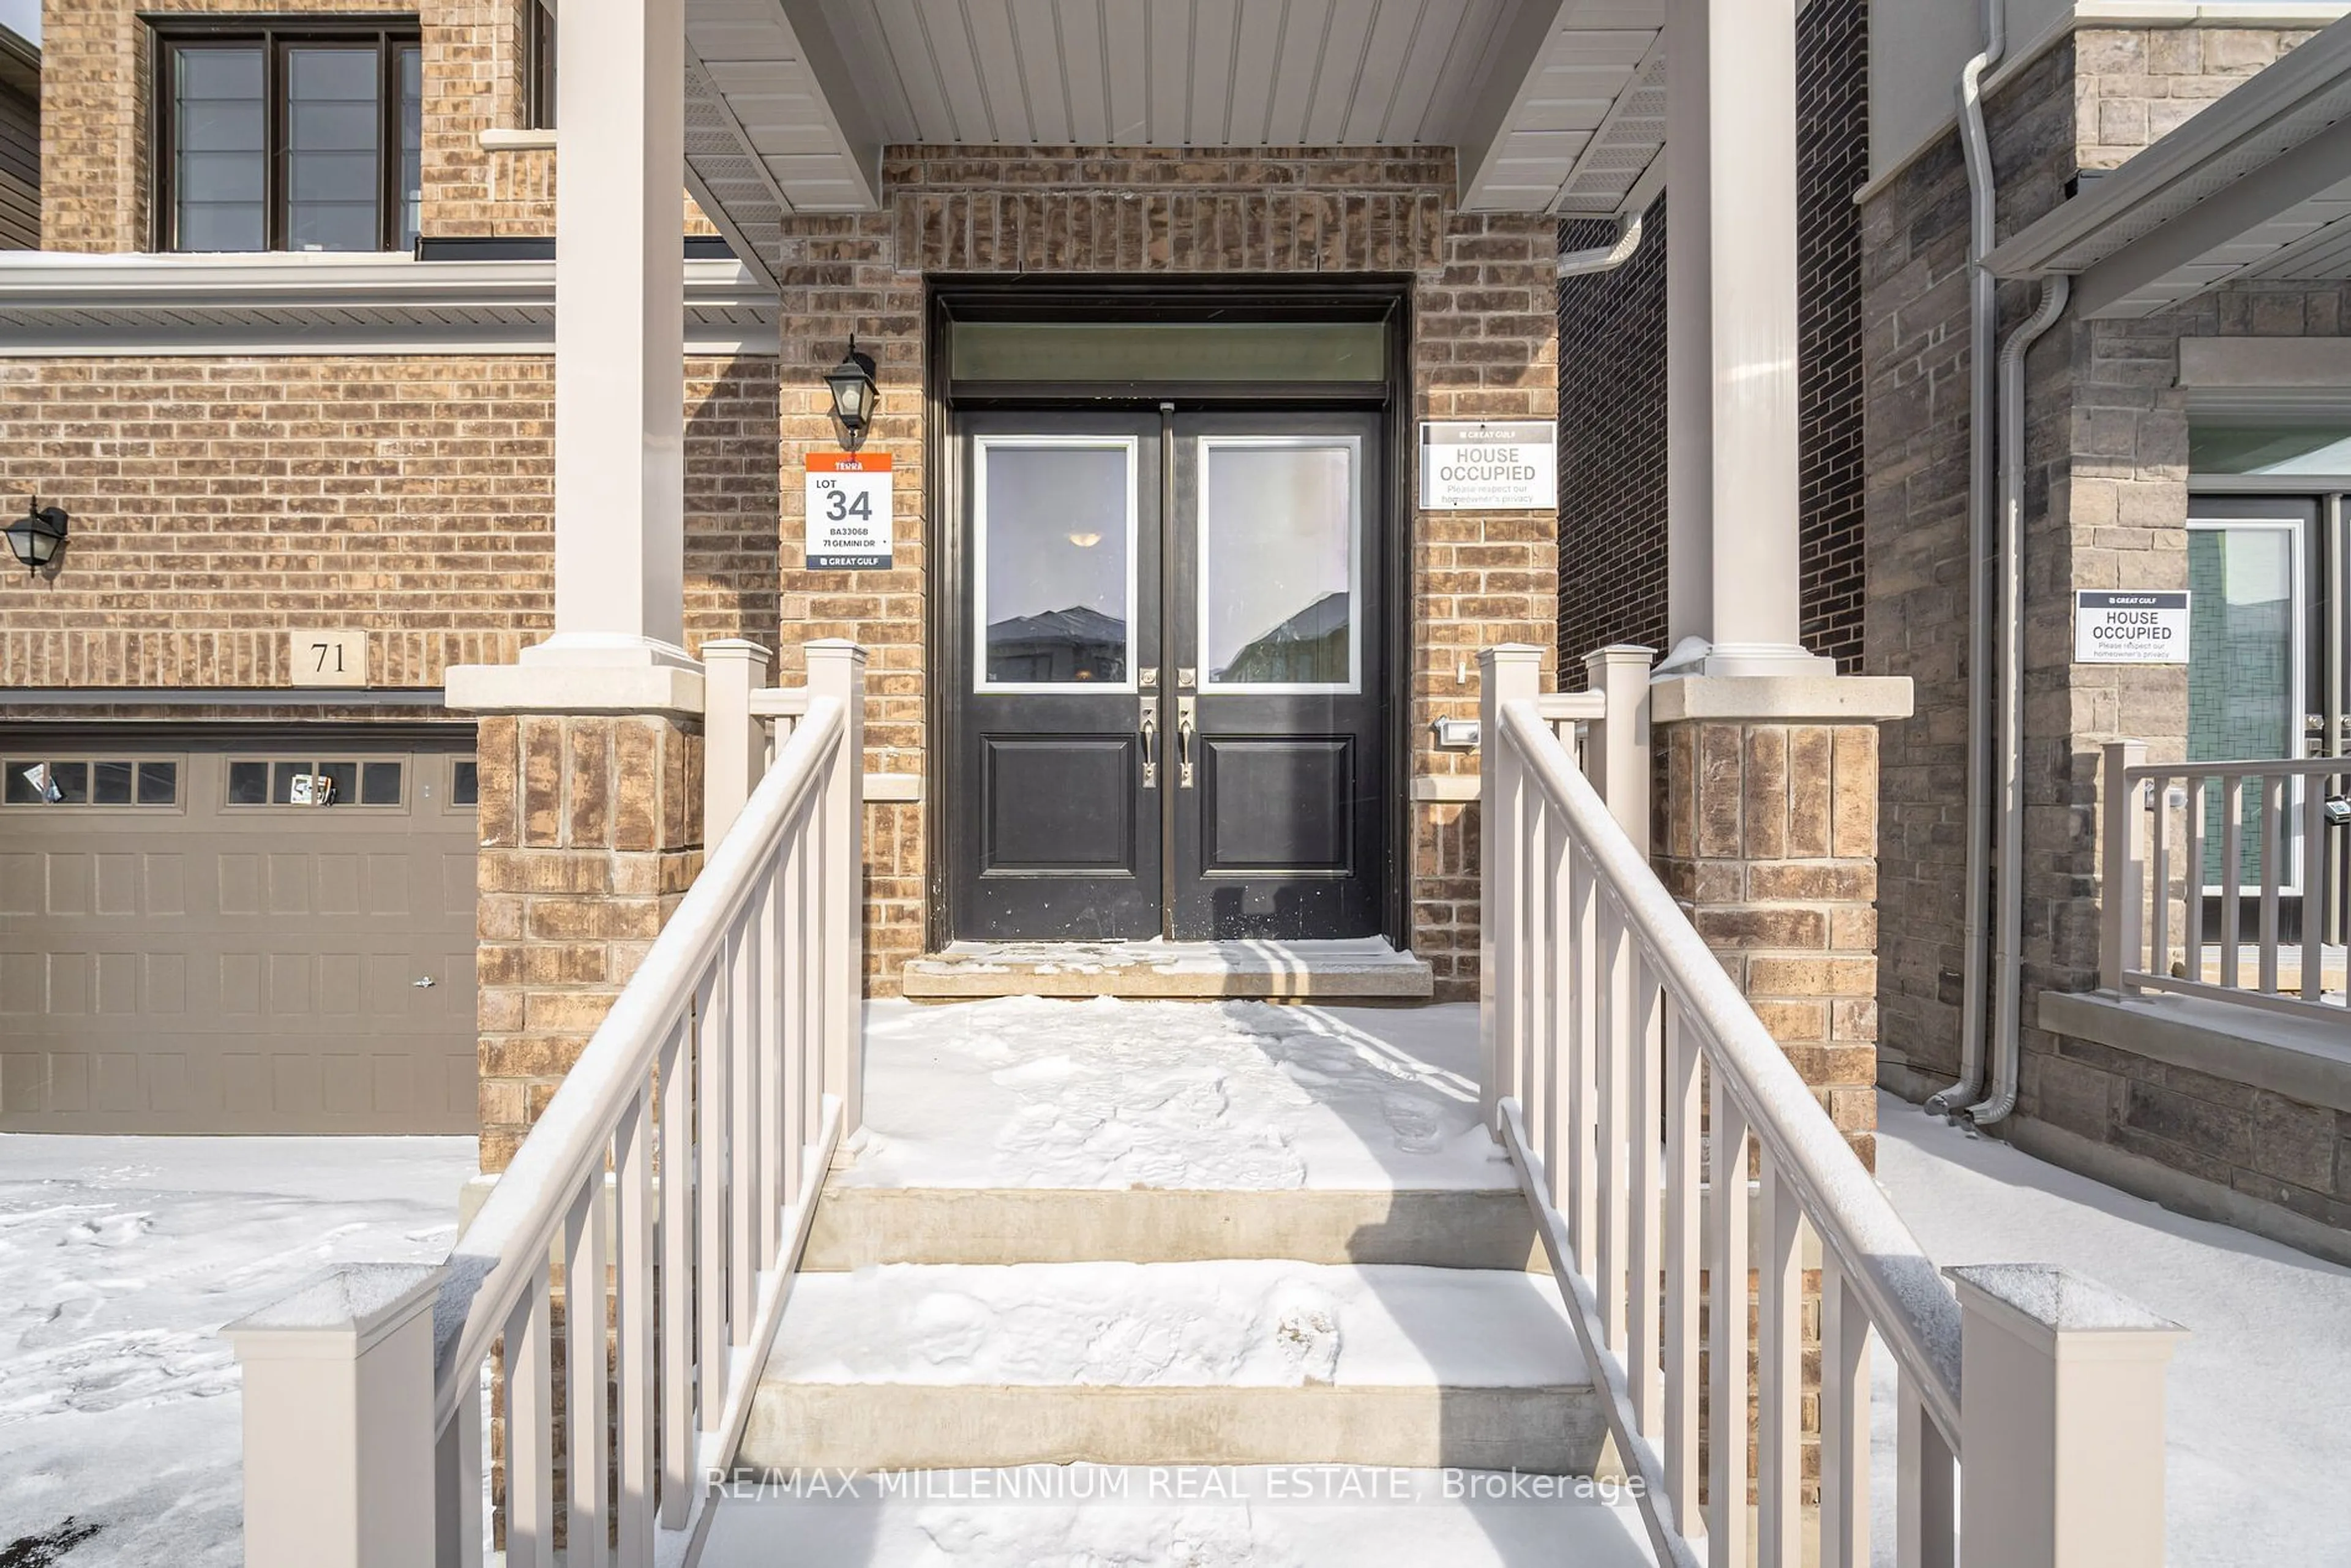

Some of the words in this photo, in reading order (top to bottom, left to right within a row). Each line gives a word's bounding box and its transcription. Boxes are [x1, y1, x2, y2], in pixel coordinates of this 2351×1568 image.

[1457, 448, 1519, 463] HOUSE
[1440, 466, 1535, 481] OCCUPIED
[816, 480, 836, 489] LOT
[1447, 485, 1476, 493] Please
[826, 490, 872, 521] 34
[2107, 612, 2159, 625] HOUSE
[2093, 626, 2172, 639] OCCUPIED
[310, 643, 345, 672] 71
